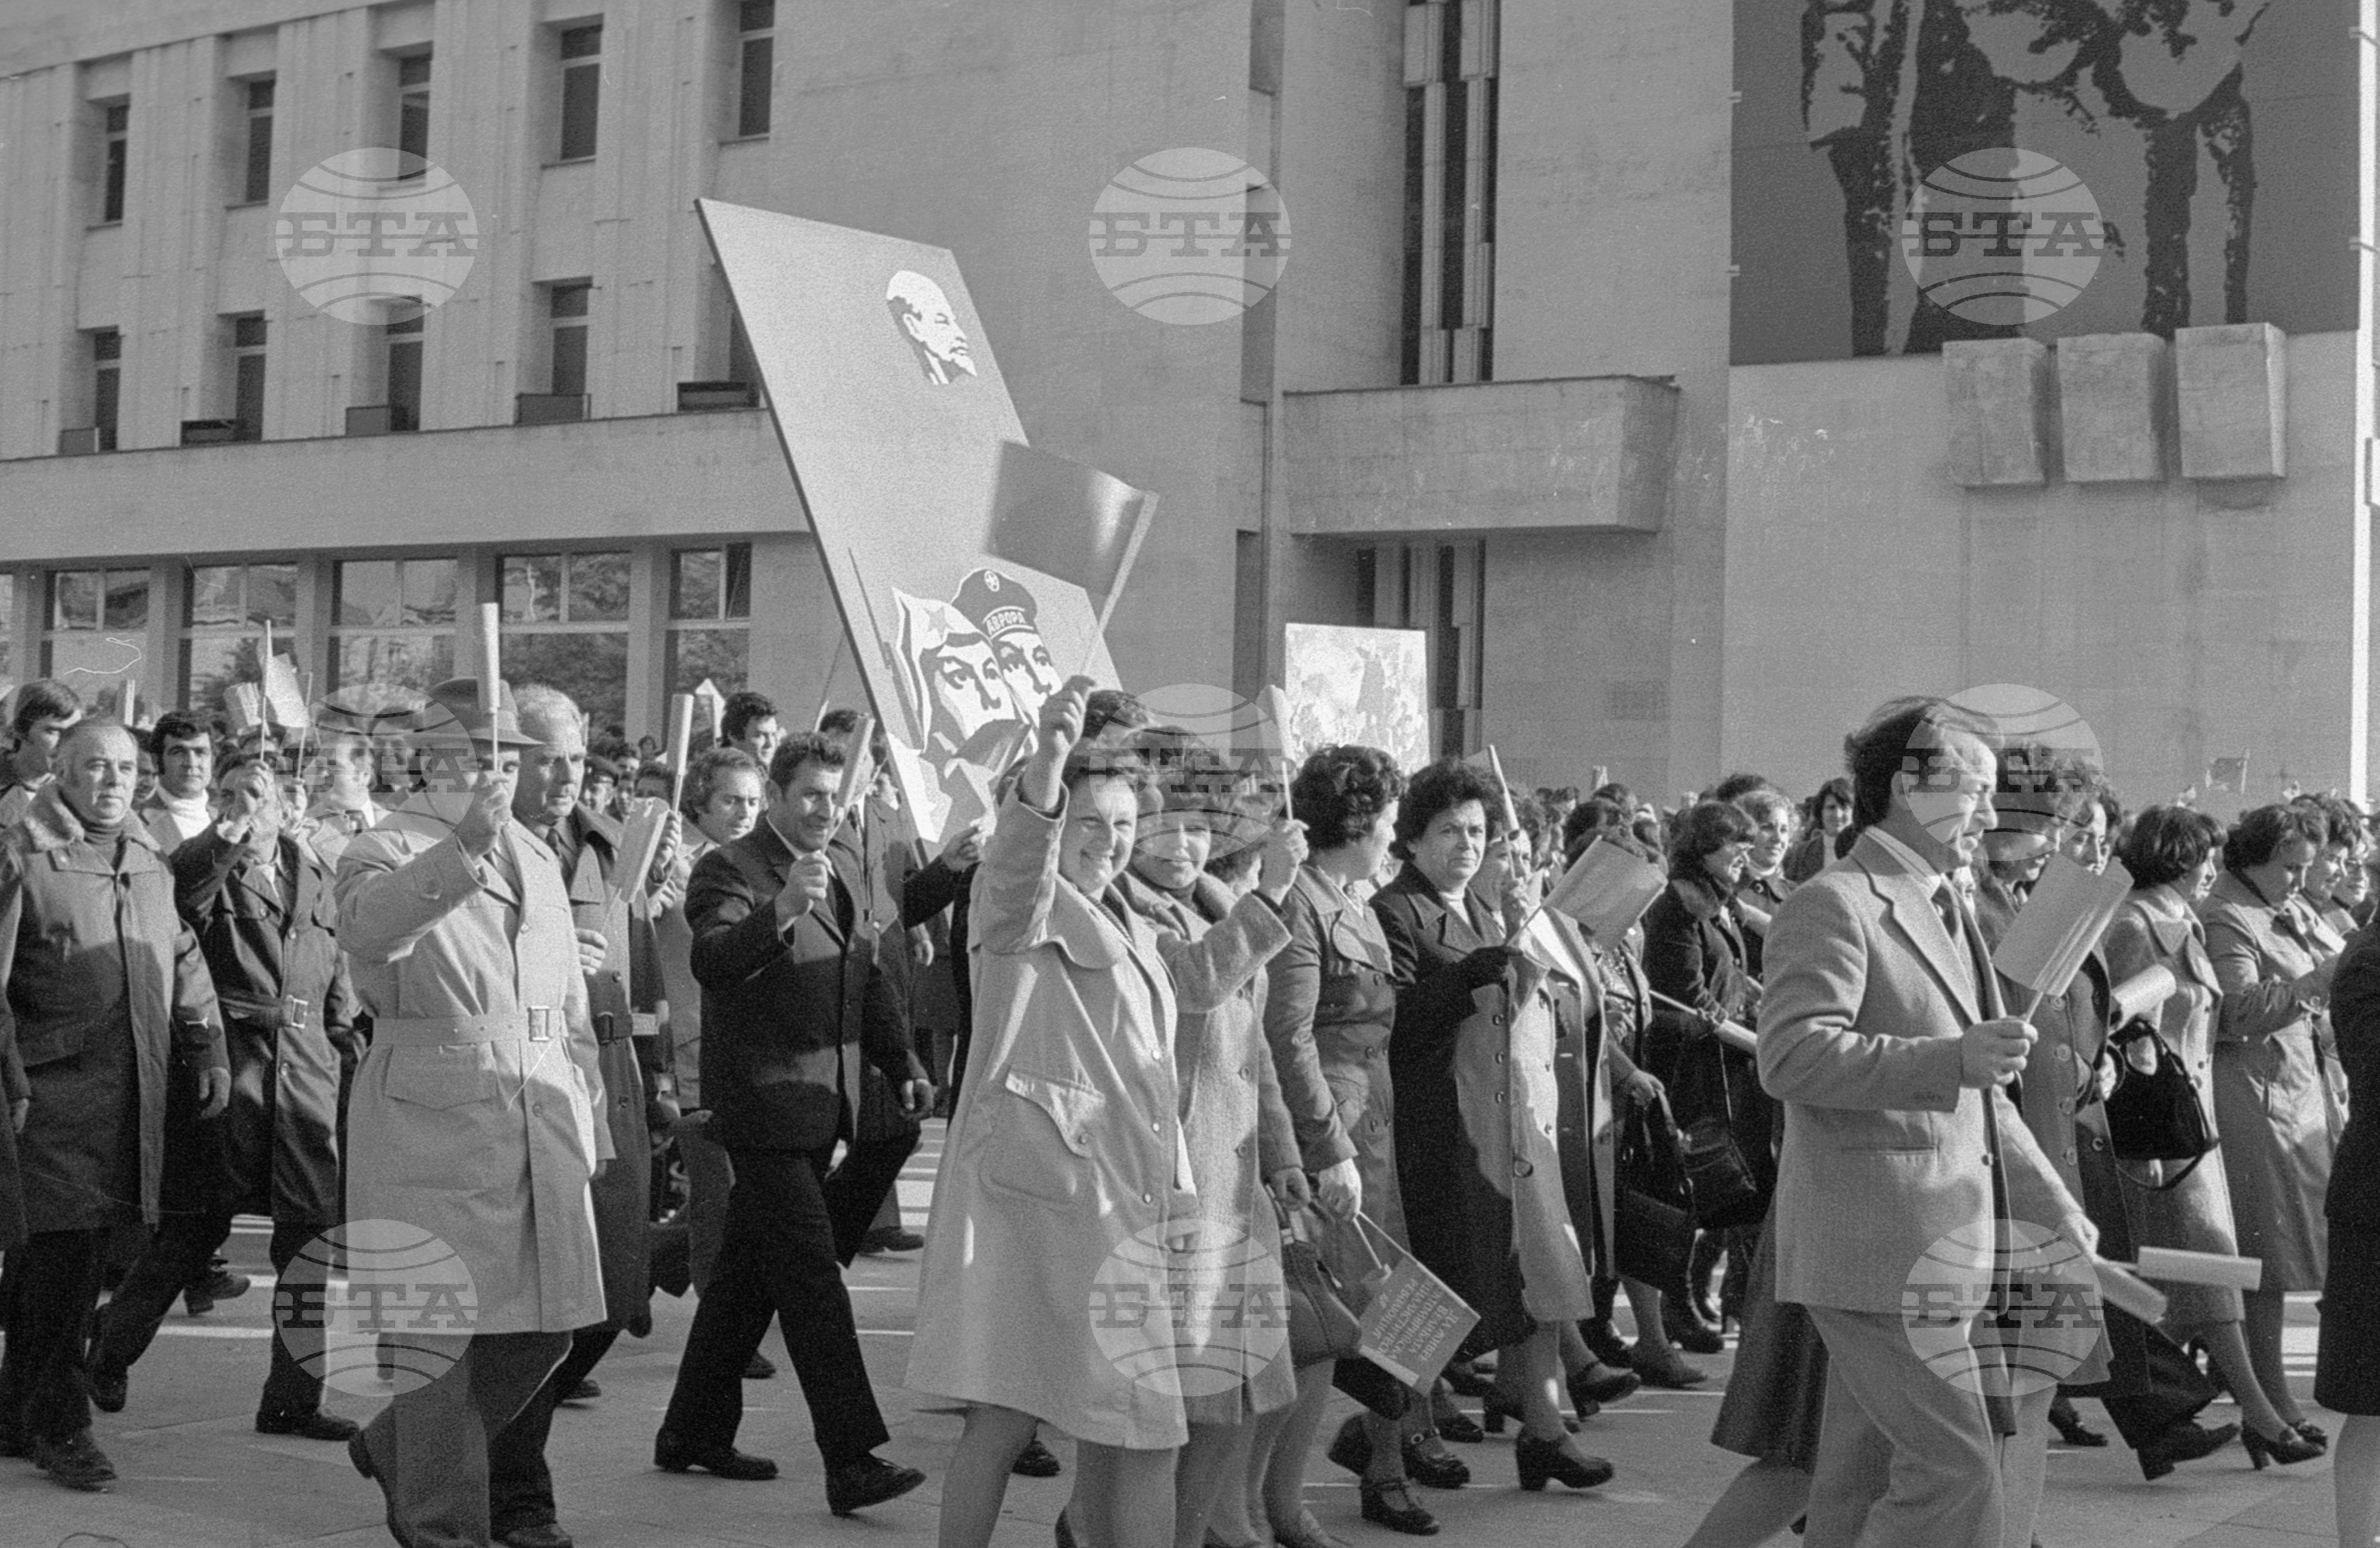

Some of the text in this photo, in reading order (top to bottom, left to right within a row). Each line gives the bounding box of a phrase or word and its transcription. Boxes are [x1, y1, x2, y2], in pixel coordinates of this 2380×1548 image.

[987, 612, 1025, 635] АВРОРА
[1371, 1277, 1418, 1339] РЕВОЛЮЦИЯ
[1407, 1303, 1448, 1355] ВЕЛИКАТА
[1417, 1310, 1460, 1364] ДА ЖИВЕЕ
